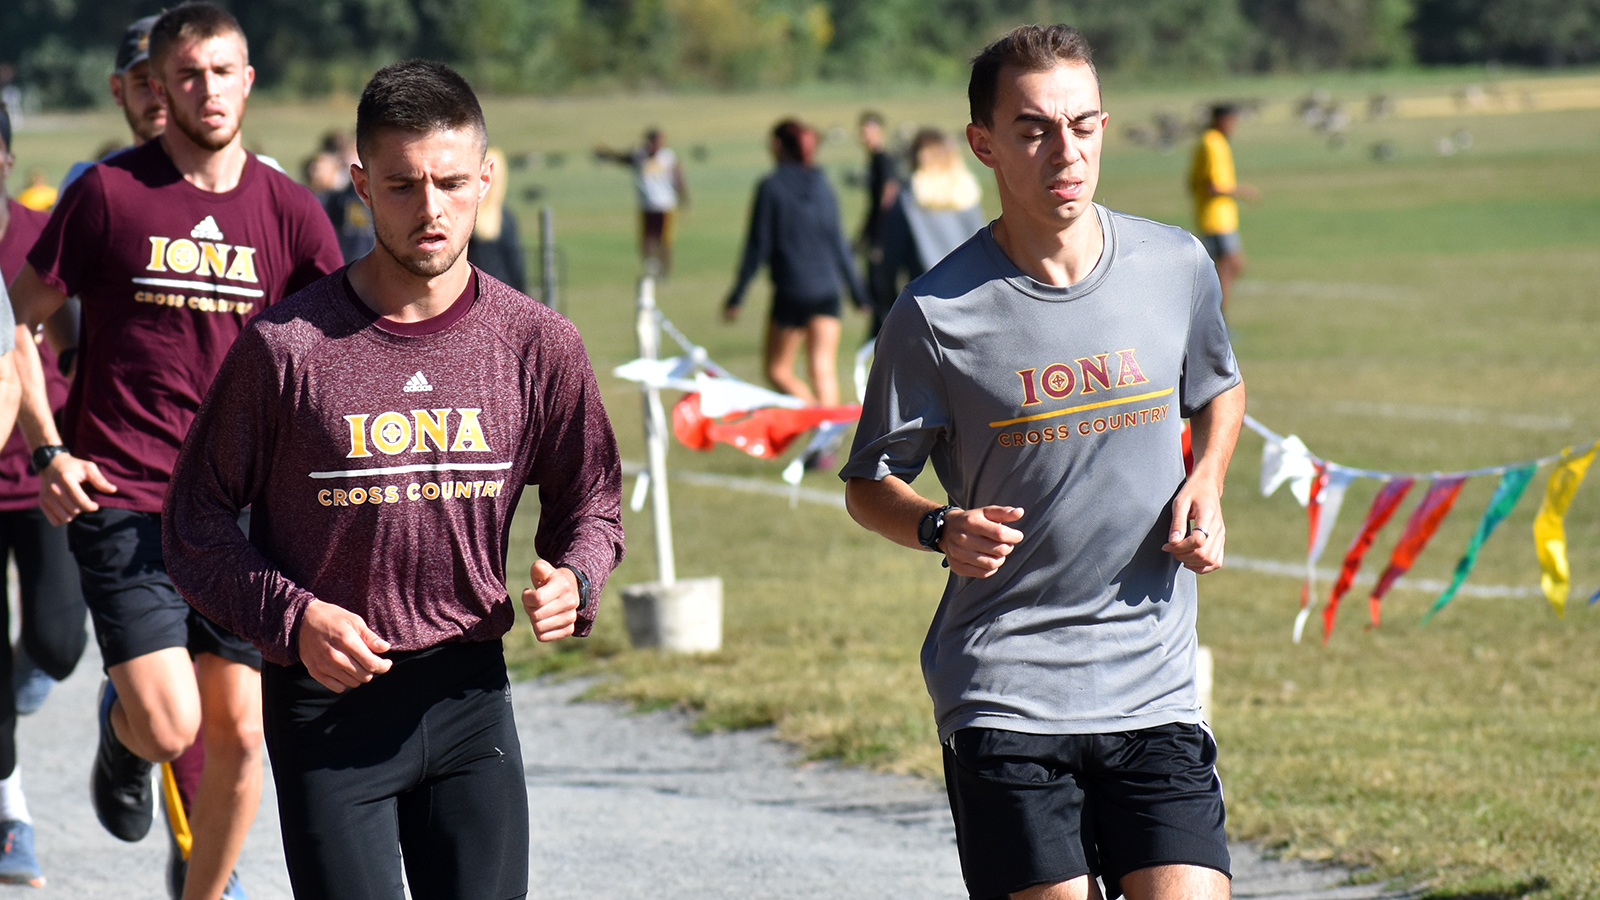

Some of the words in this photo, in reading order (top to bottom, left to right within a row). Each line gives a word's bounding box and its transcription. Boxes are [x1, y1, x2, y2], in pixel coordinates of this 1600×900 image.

[146, 236, 258, 283] IONA
[134, 291, 185, 307] CROSS
[1016, 348, 1149, 407] IONA
[343, 408, 491, 458] IONA
[998, 425, 1069, 447] CROSS
[1077, 404, 1170, 436] COUNTRY
[318, 486, 399, 506] CROSS
[406, 479, 505, 500] COUNTRY
